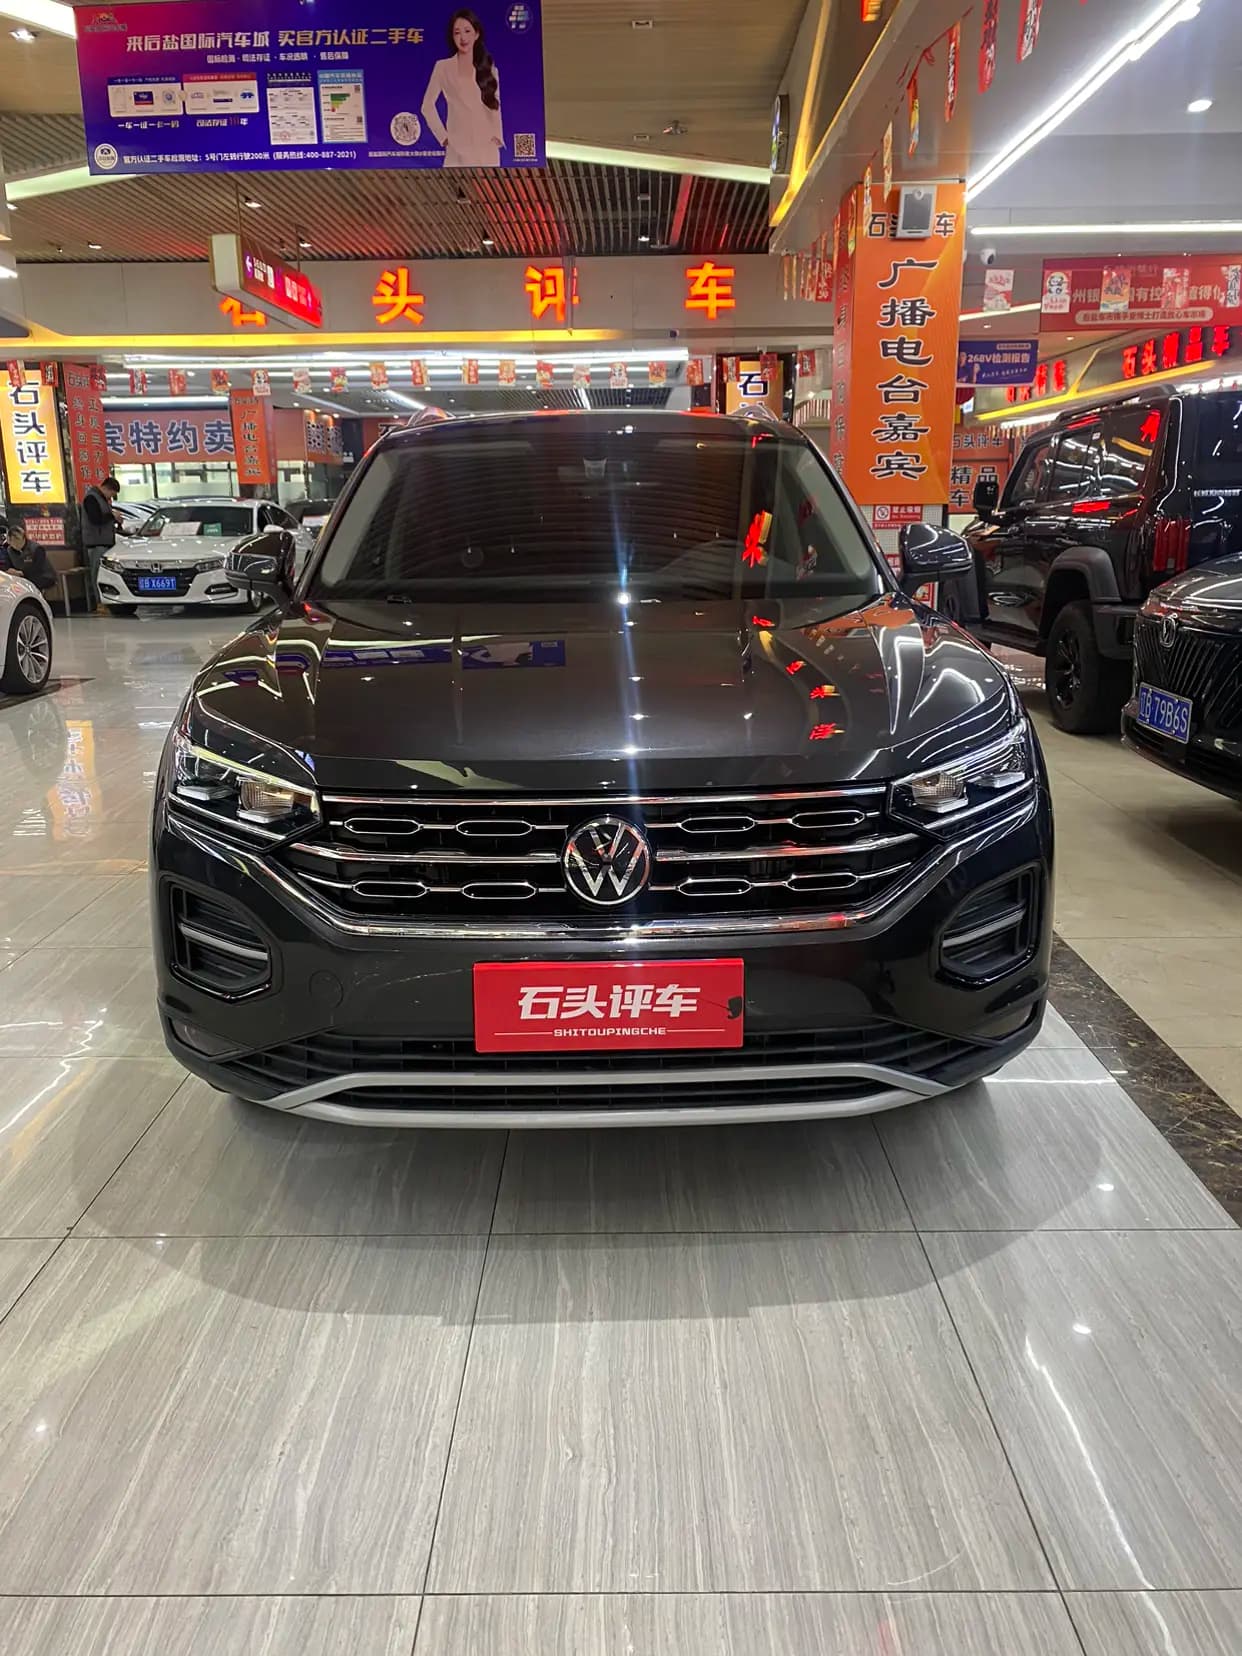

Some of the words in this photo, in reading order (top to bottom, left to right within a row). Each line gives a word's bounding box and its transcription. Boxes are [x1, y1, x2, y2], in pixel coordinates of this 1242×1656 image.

[126, 31, 269, 52] 来后盐国际汽车城
[278, 28, 425, 47] 买官方认证二手车
[868, 212, 956, 238] 石车
[870, 258, 938, 480] 广播电台嘉宾
[967, 352, 1030, 364] 268V检测报告
[8, 380, 52, 494] 石头评车
[518, 983, 701, 1020] 石头评车
[553, 1027, 667, 1037] SHITOUPINGCHE
